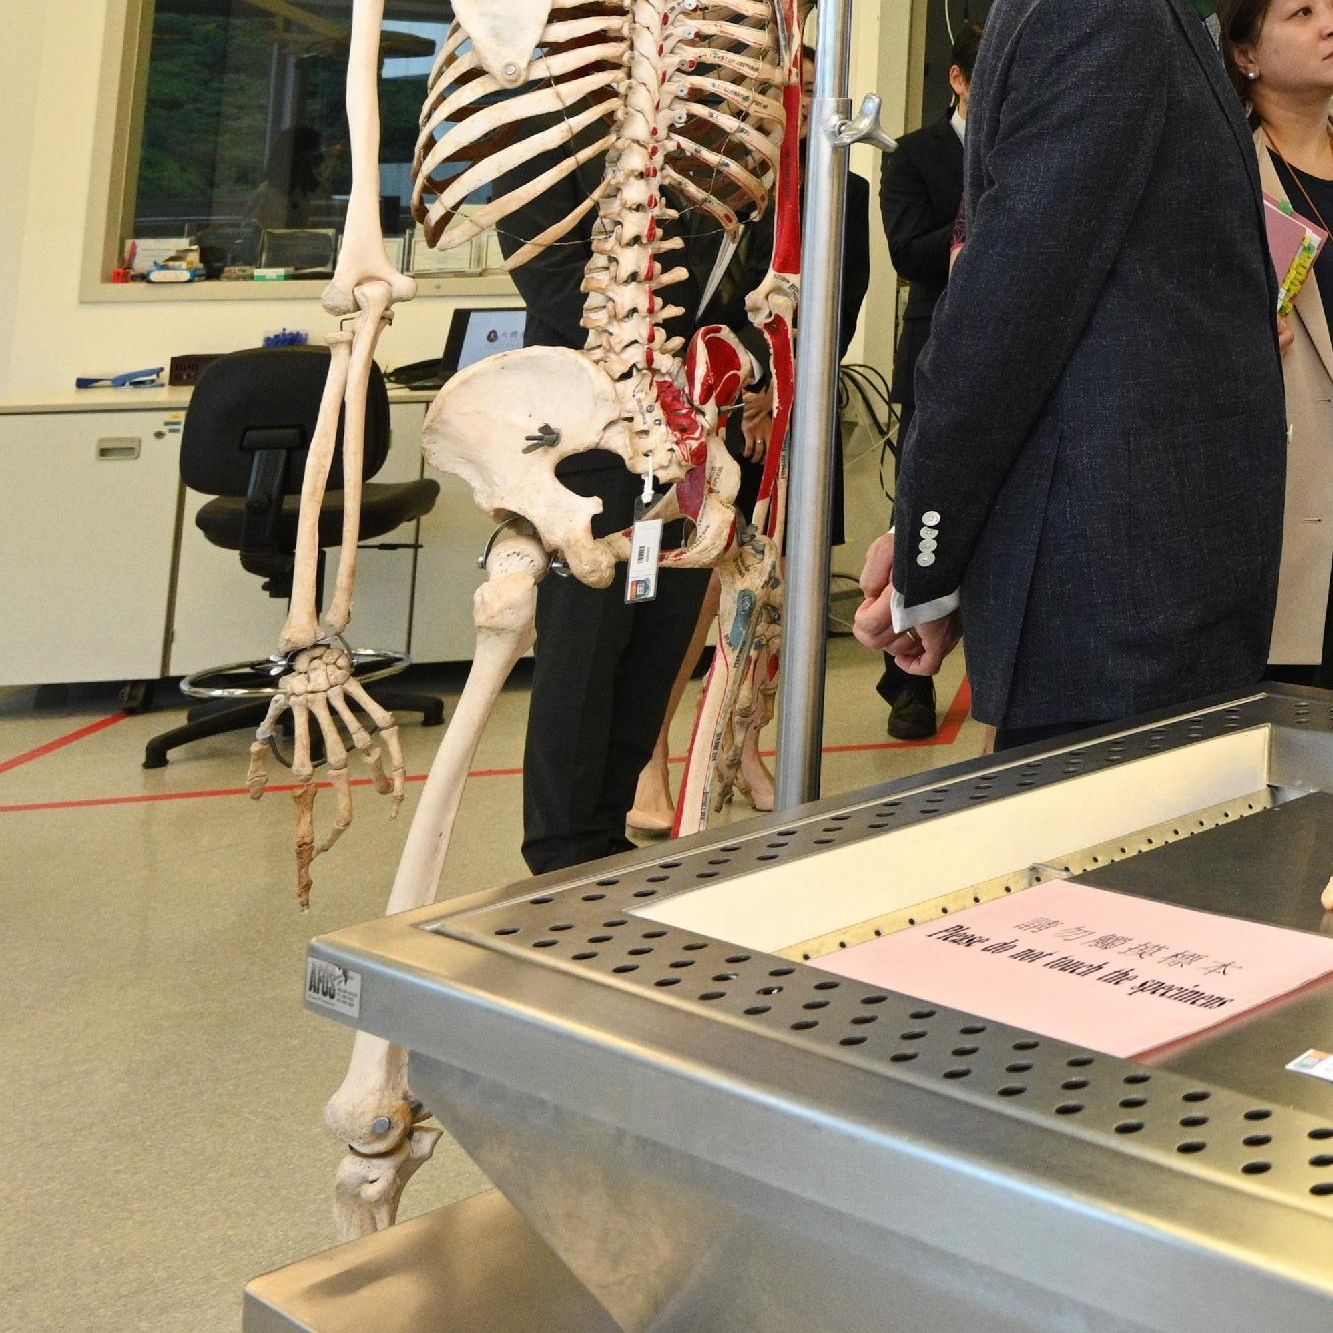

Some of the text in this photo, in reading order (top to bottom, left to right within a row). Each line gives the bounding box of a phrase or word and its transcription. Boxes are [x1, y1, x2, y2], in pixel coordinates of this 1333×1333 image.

[926, 924, 1235, 1010] Please do not touch the specimens
